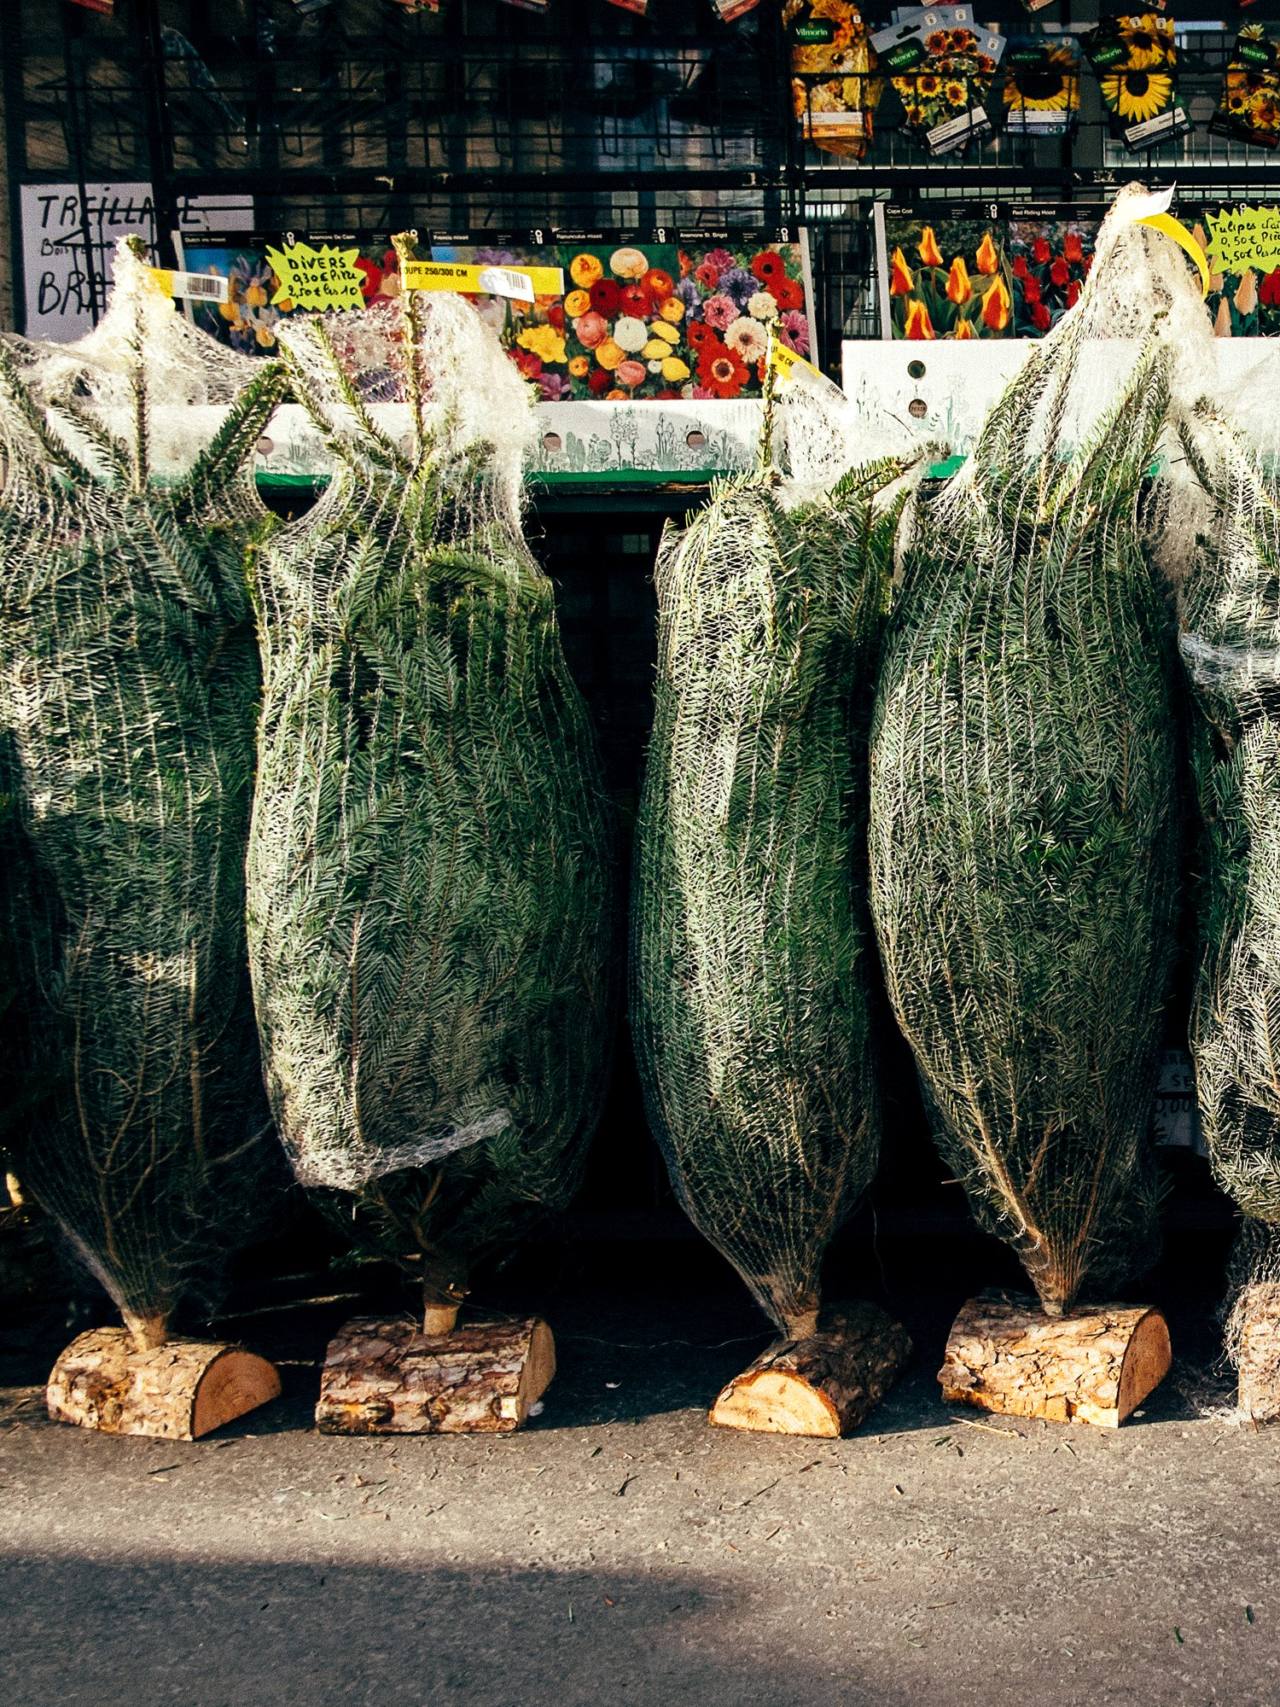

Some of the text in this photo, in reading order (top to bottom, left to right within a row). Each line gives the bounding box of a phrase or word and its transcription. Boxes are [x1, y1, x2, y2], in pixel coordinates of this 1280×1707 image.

[796, 27, 829, 37] Vilmorin
[887, 49, 919, 66] Vilmorin
[1091, 48, 1123, 64] Vilmorin
[1210, 221, 1256, 235] Tulipes
[424, 267, 454, 276] 250/300
[455, 269, 468, 277] CM
